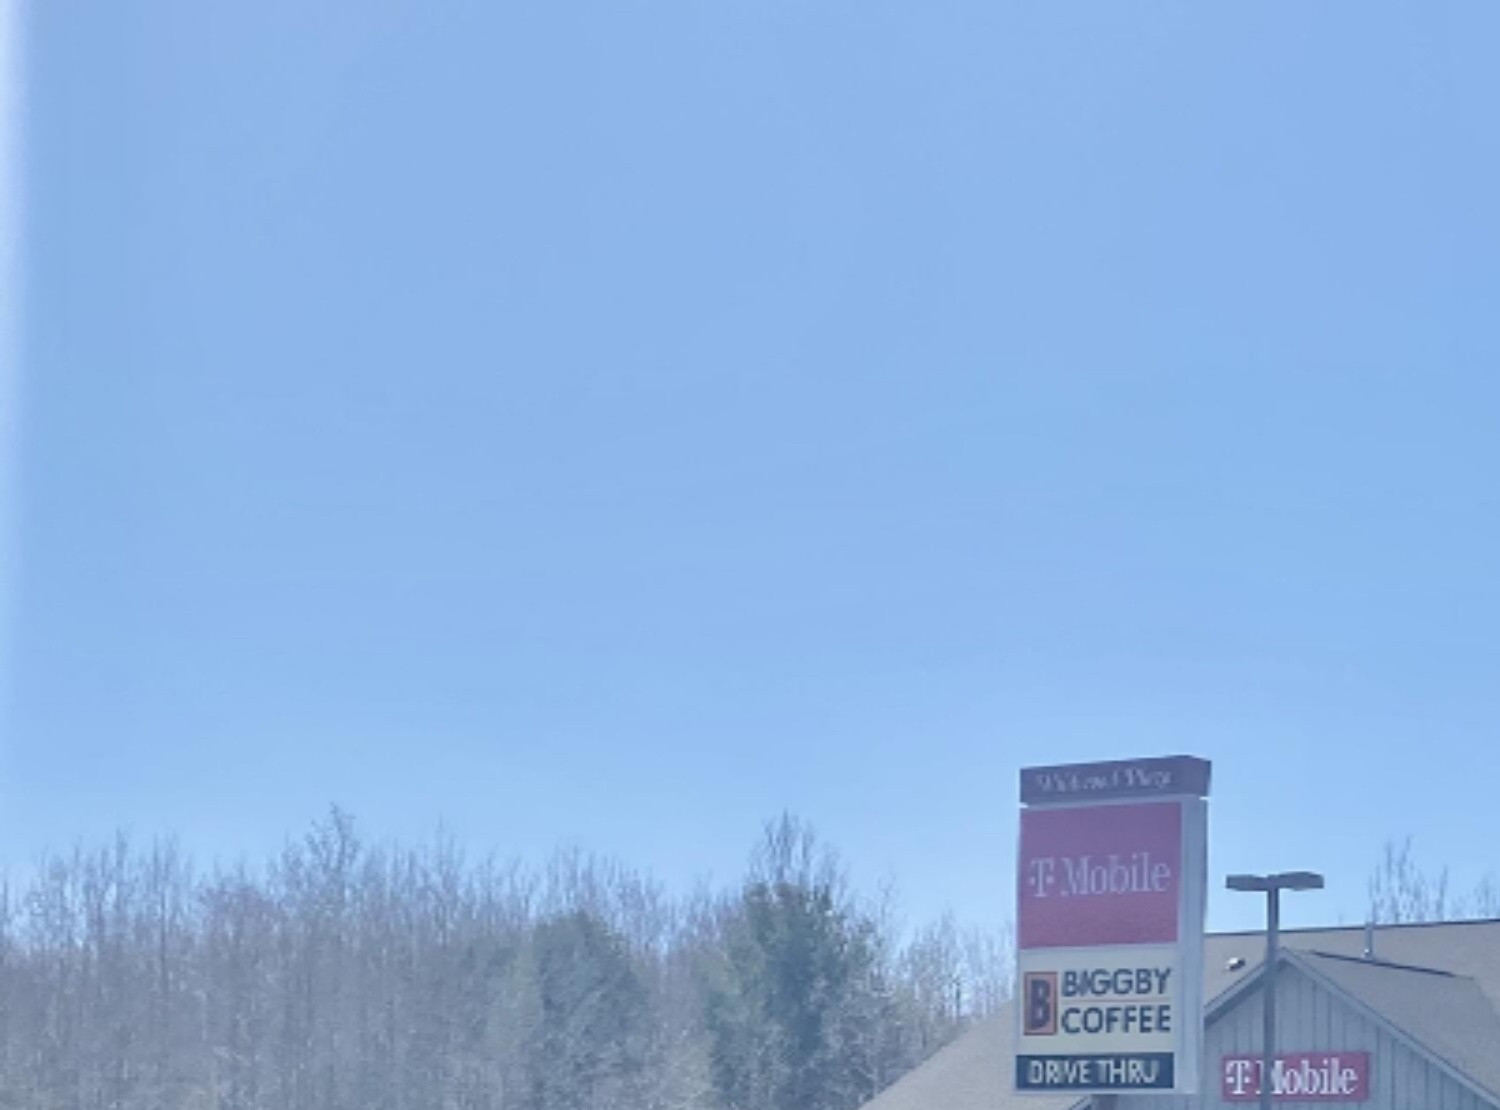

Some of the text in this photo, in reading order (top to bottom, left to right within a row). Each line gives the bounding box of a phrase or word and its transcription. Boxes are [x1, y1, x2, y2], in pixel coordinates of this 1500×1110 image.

[1060, 851, 1172, 895] Mobile
[1062, 967, 1171, 997] BIGGBY
[1061, 1004, 1171, 1034] COFFEE
[1095, 1058, 1160, 1084] THRU
